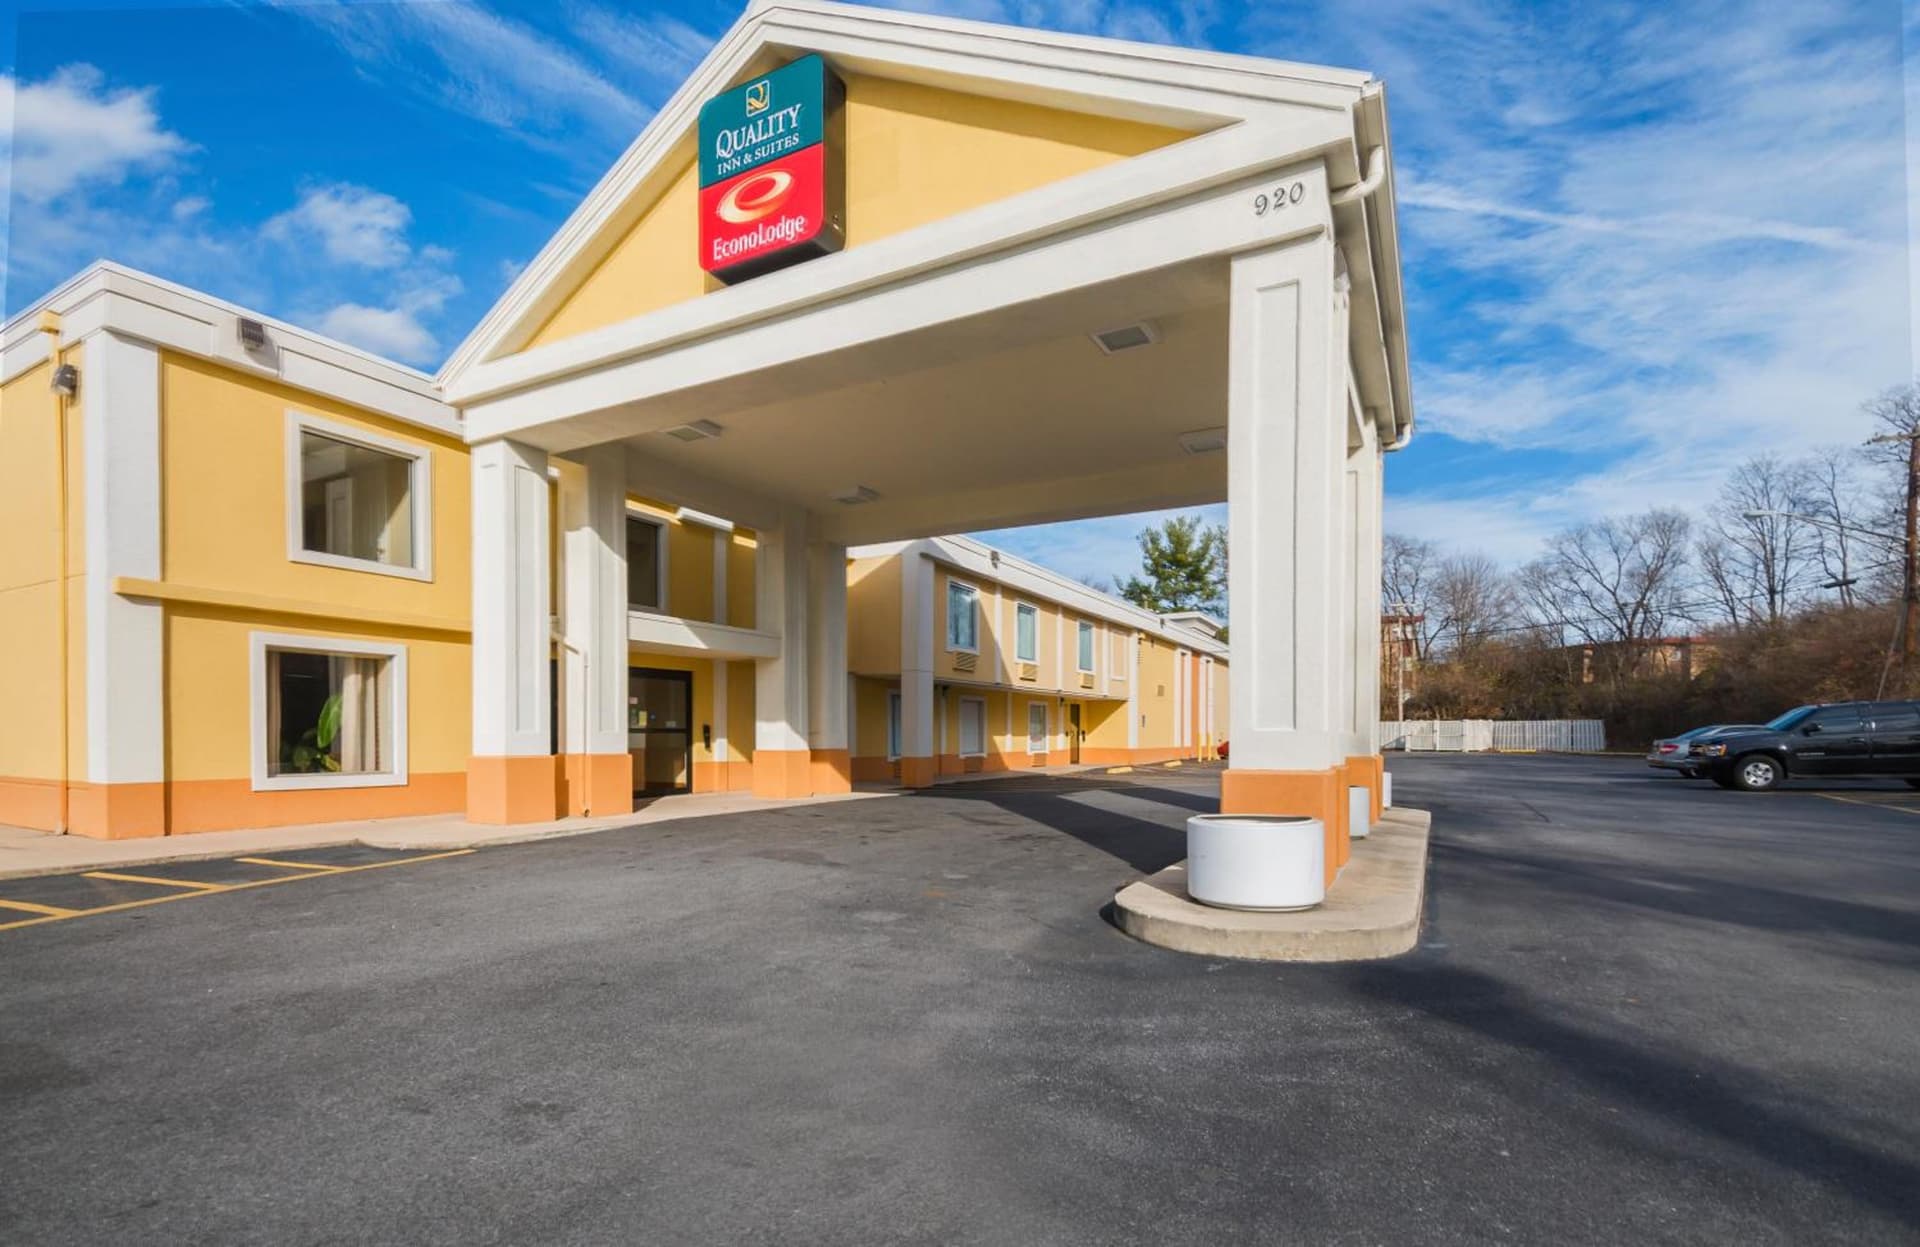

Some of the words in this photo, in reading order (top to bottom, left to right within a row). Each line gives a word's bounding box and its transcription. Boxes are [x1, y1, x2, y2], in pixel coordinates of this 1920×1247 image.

[716, 103, 802, 158] QUALITY
[718, 156, 741, 175] INN
[743, 153, 752, 165] &
[754, 133, 799, 161] SUITES
[1255, 182, 1303, 216] 920
[713, 215, 805, 260] EconoLodge
